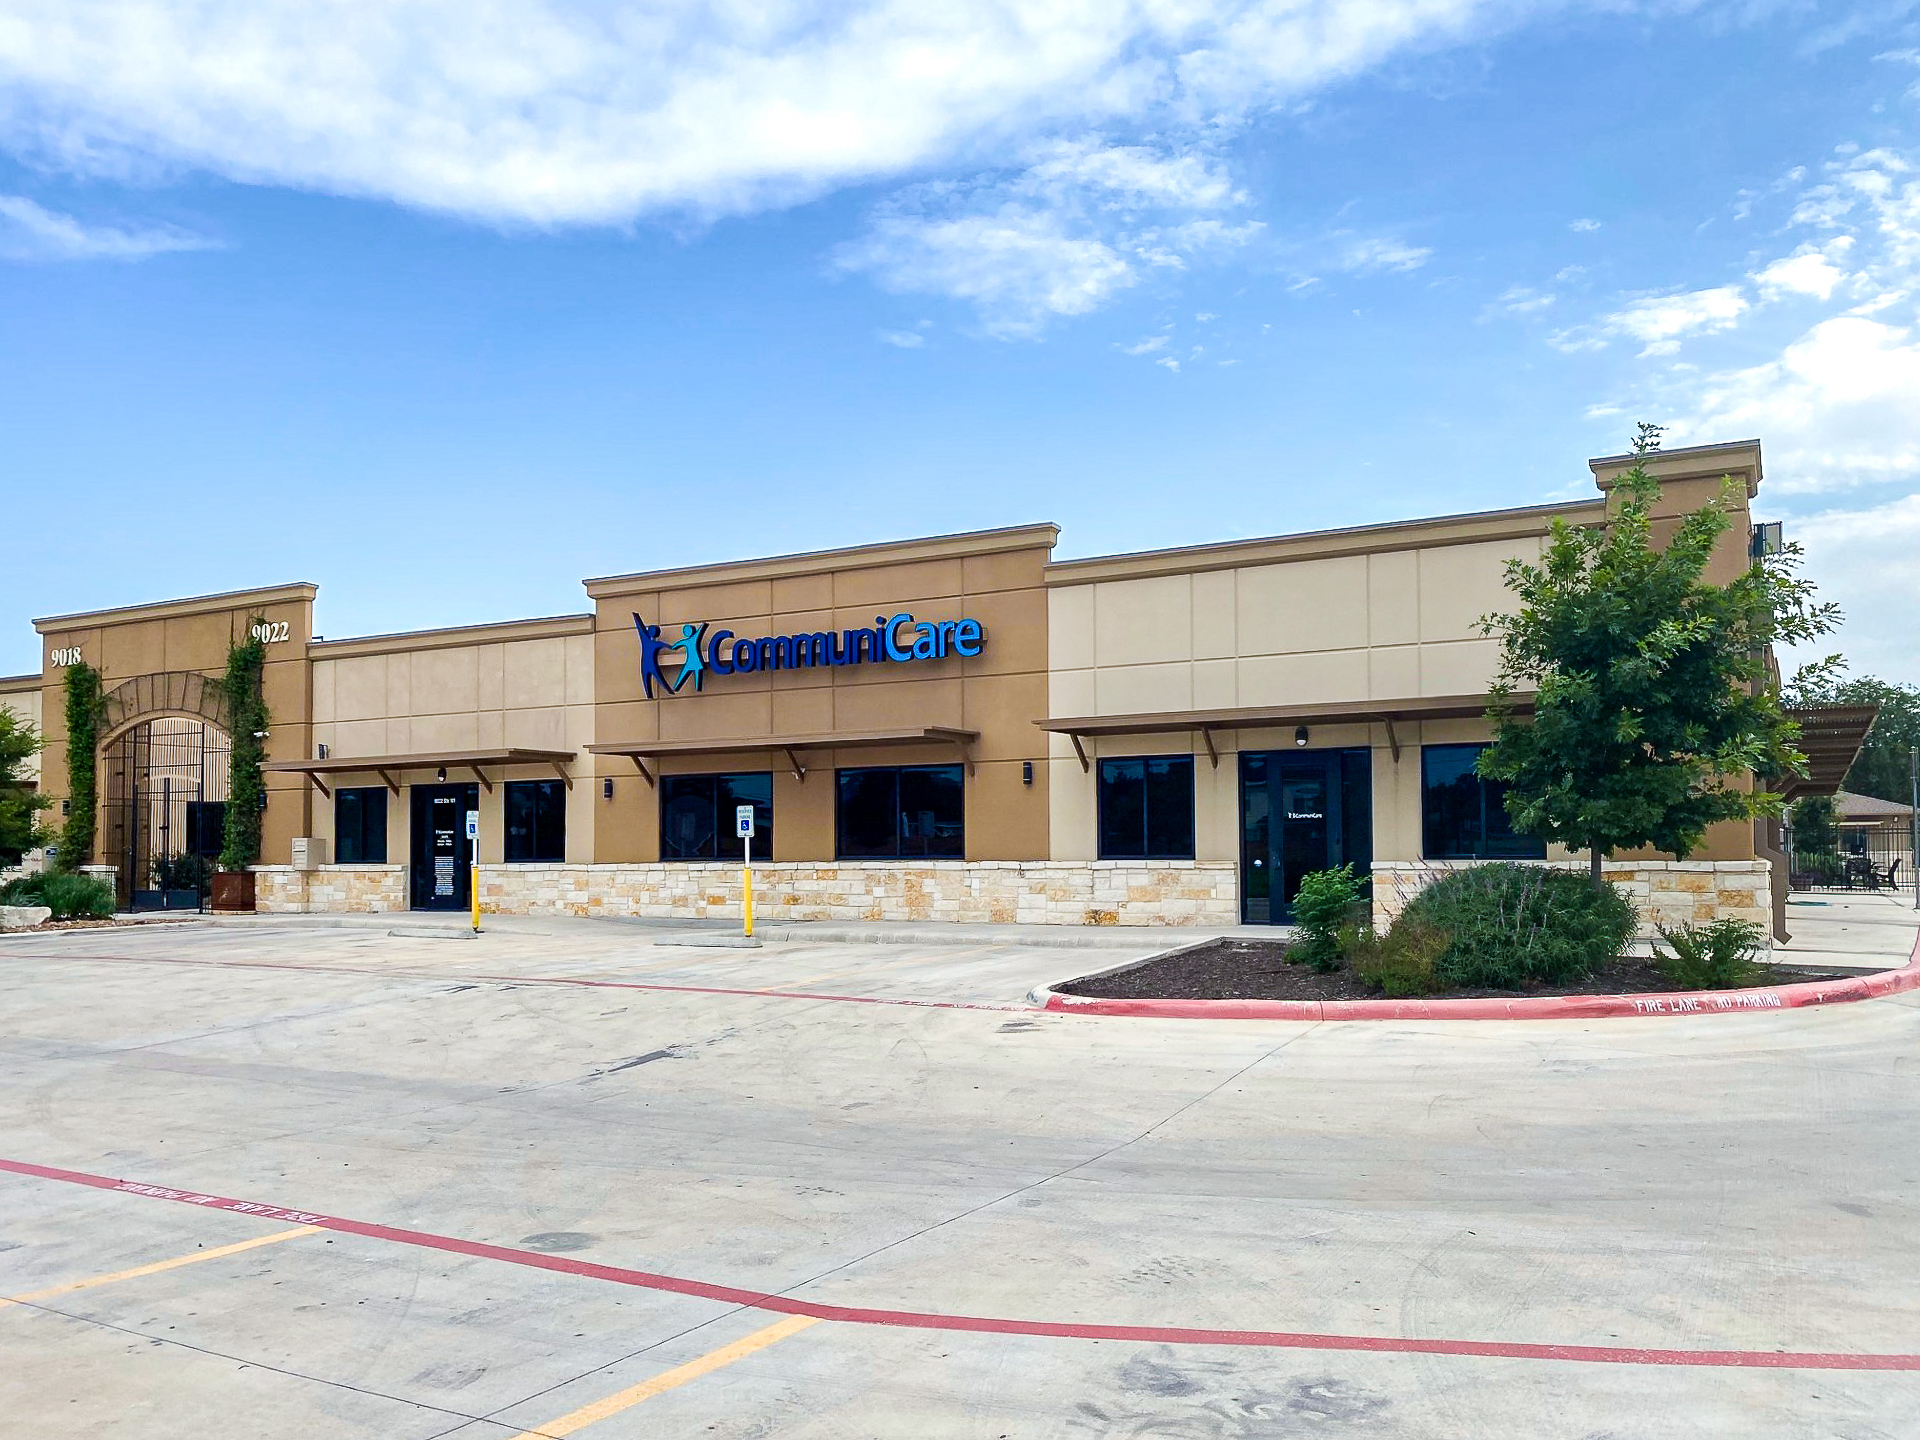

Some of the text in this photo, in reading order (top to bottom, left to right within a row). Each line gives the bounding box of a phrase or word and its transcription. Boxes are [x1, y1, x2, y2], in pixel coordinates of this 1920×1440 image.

[252, 621, 290, 644] 9022
[708, 613, 983, 675] CommuniCare
[51, 647, 82, 668] 9018
[1635, 993, 1781, 1013] FIRE LANE NO PARKING
